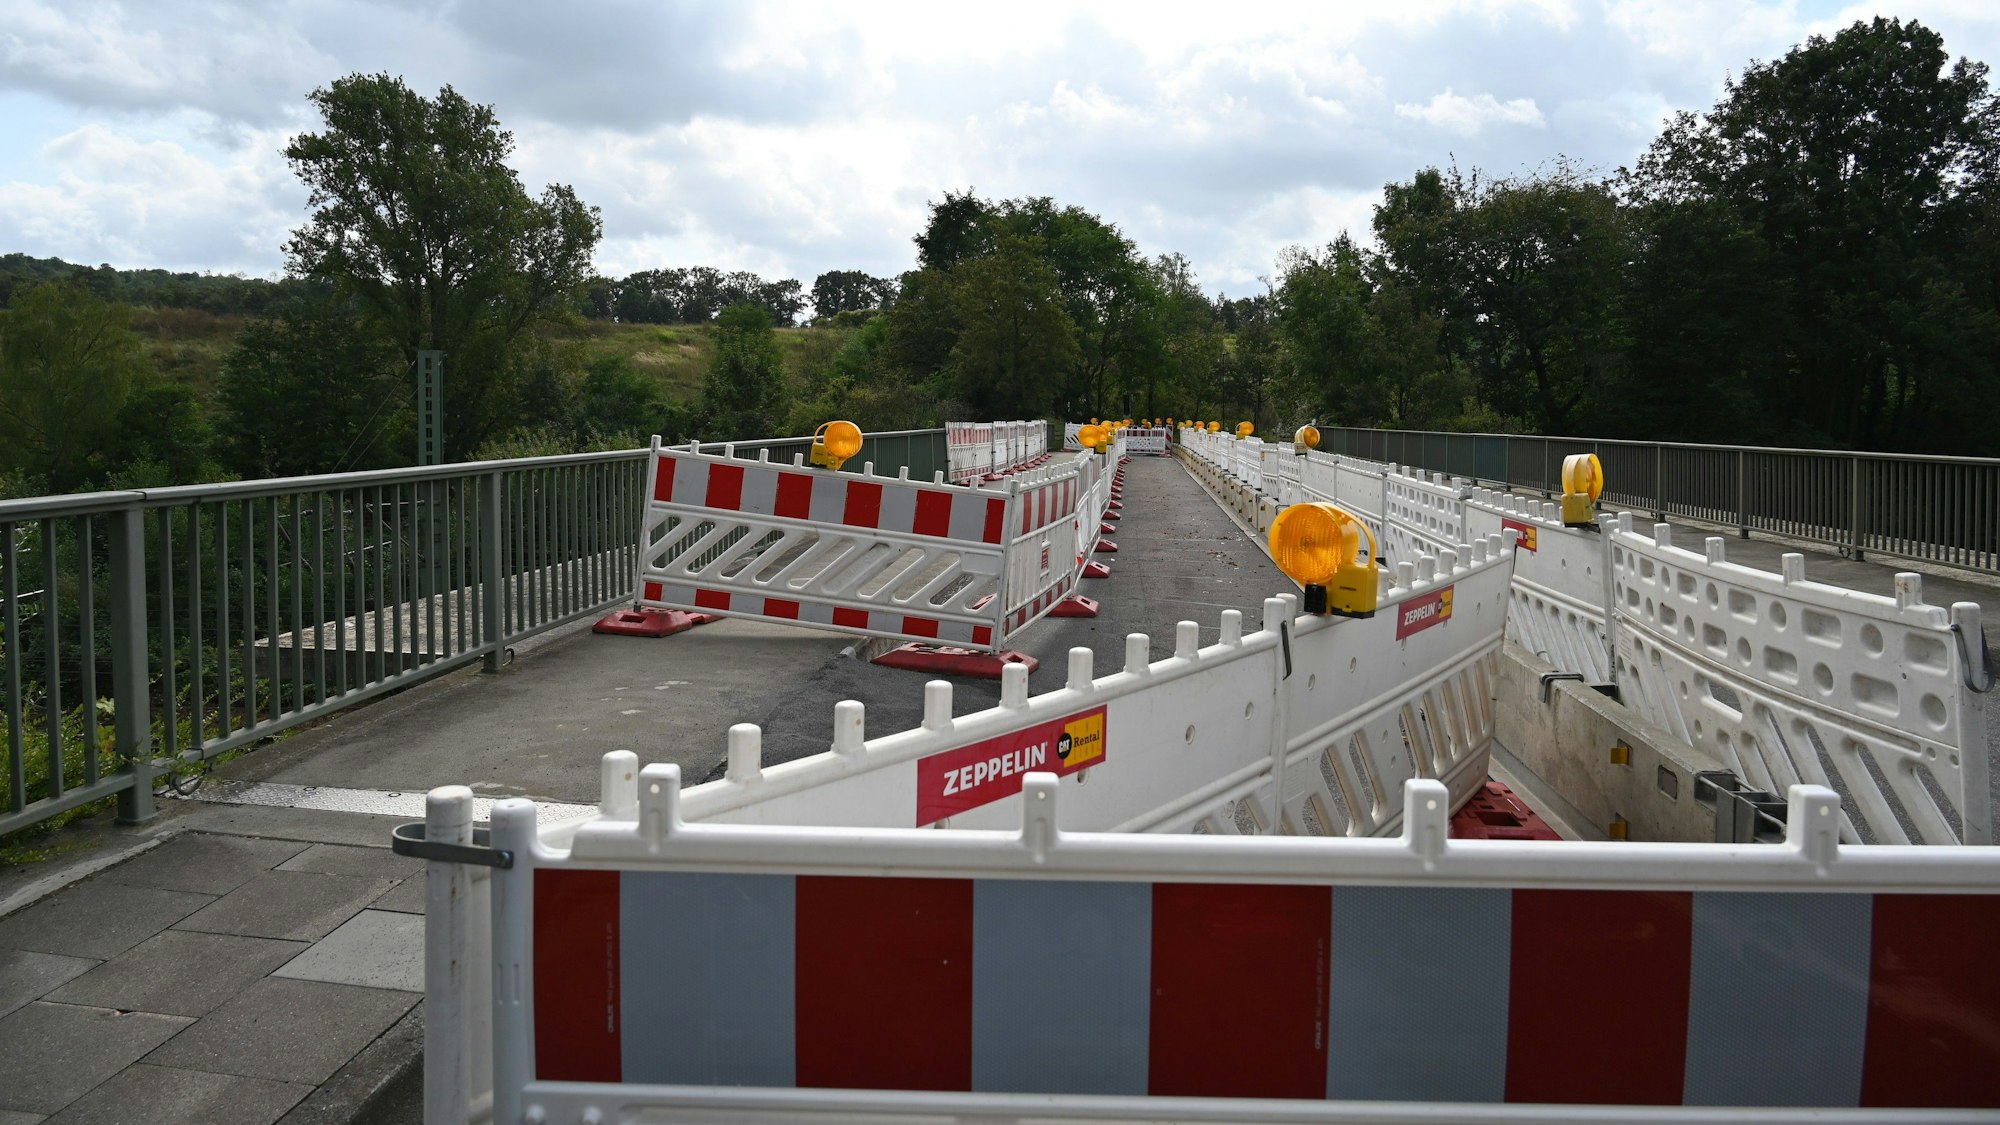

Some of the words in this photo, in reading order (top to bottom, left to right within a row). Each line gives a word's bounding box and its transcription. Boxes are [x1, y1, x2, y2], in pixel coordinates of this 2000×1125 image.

[1404, 602, 1435, 626] ZEPPELIN
[943, 742, 1046, 796] ZEPPELIN
[1058, 739, 1070, 753] CAT
[1073, 730, 1100, 748] Rental
